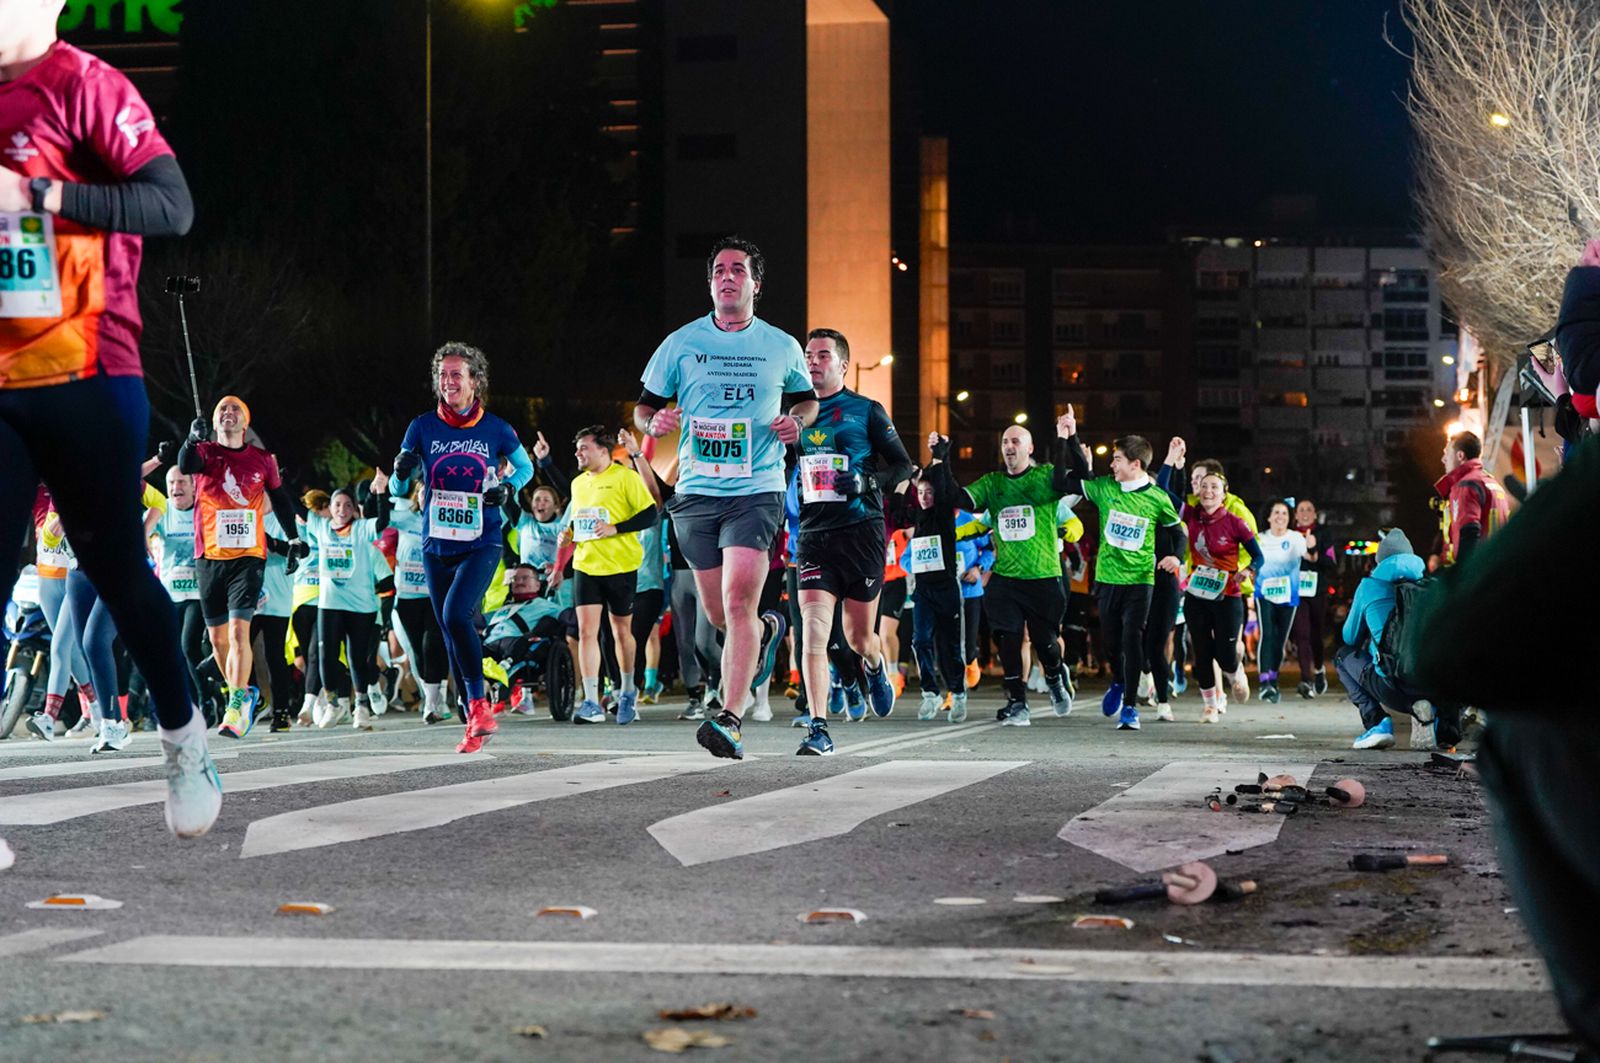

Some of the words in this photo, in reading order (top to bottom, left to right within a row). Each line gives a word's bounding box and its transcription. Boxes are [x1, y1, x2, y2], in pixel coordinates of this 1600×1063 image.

[695, 354, 708, 364] VI
[438, 507, 473, 524] 8366
[225, 523, 249, 535] 1955
[1005, 518, 1027, 529] 3913
[1110, 523, 1141, 539] 13226
[404, 572, 426, 583] 1322
